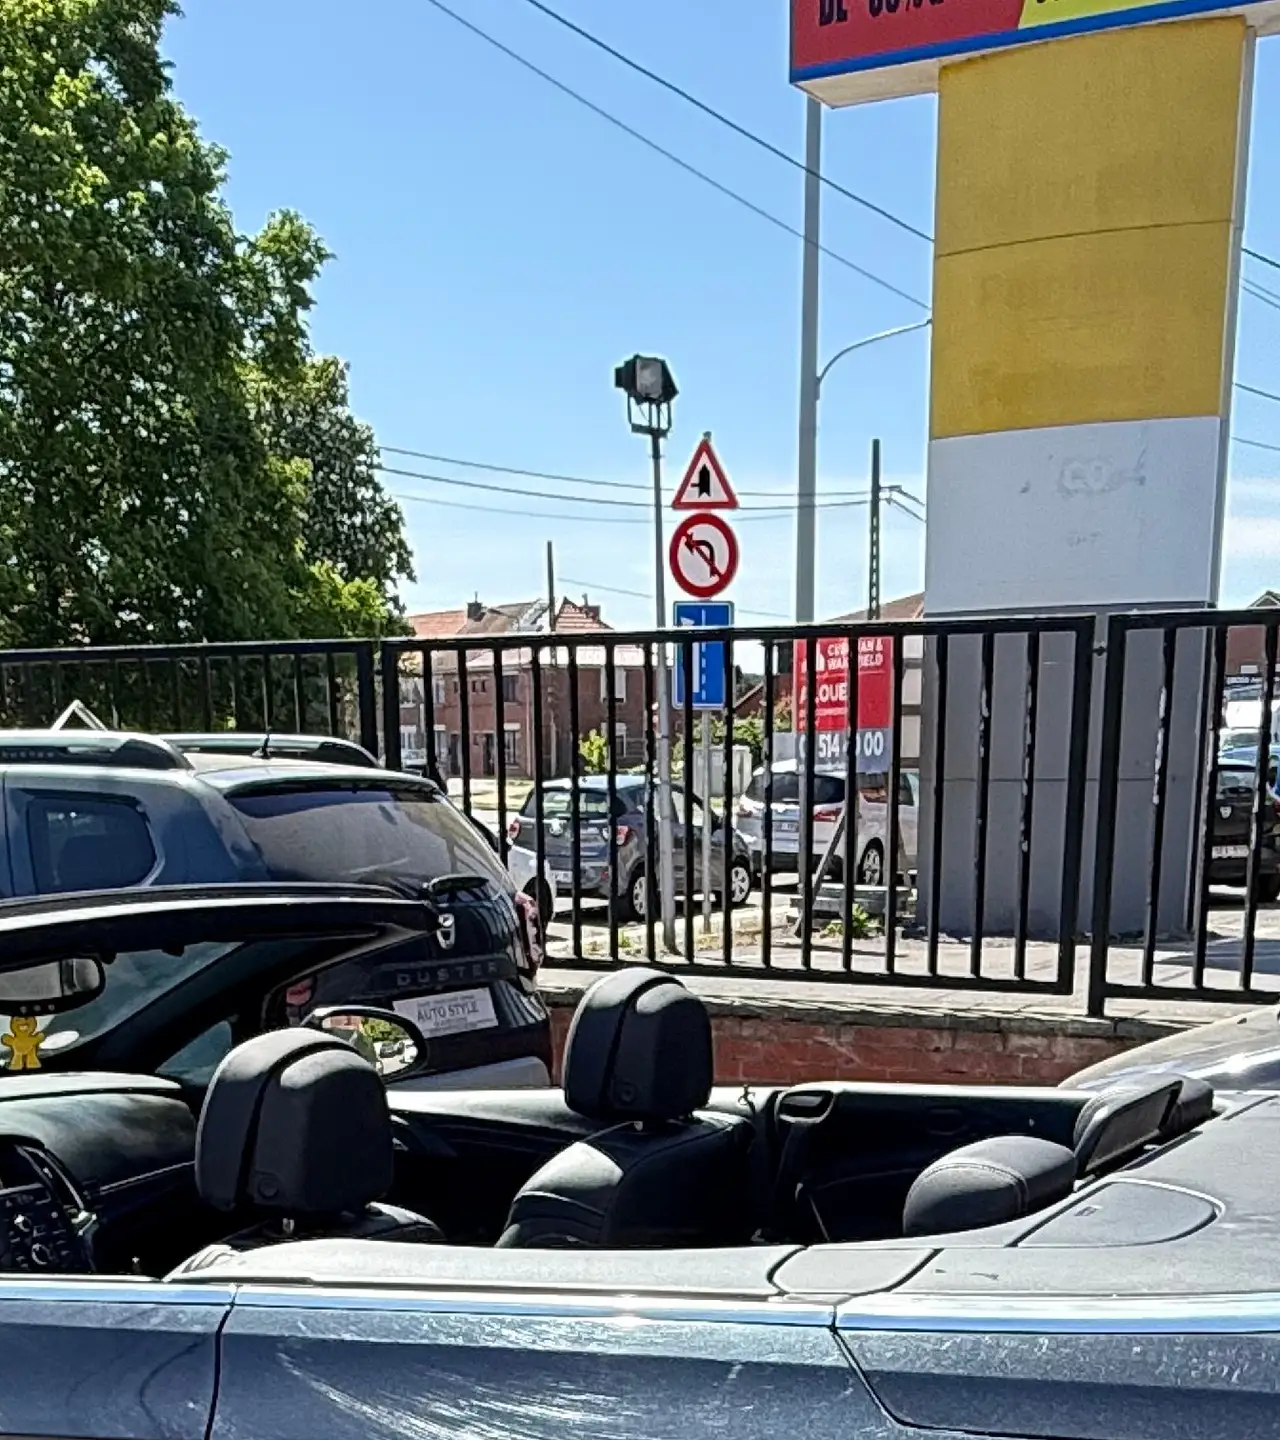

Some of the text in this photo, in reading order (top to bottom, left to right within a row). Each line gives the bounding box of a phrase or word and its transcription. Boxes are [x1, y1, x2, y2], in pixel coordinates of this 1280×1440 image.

[818, 734, 840, 758] 514
[863, 731, 884, 757] 00
[396, 962, 498, 986] DUSTER
[417, 1001, 479, 1021] AUTO STYLE
